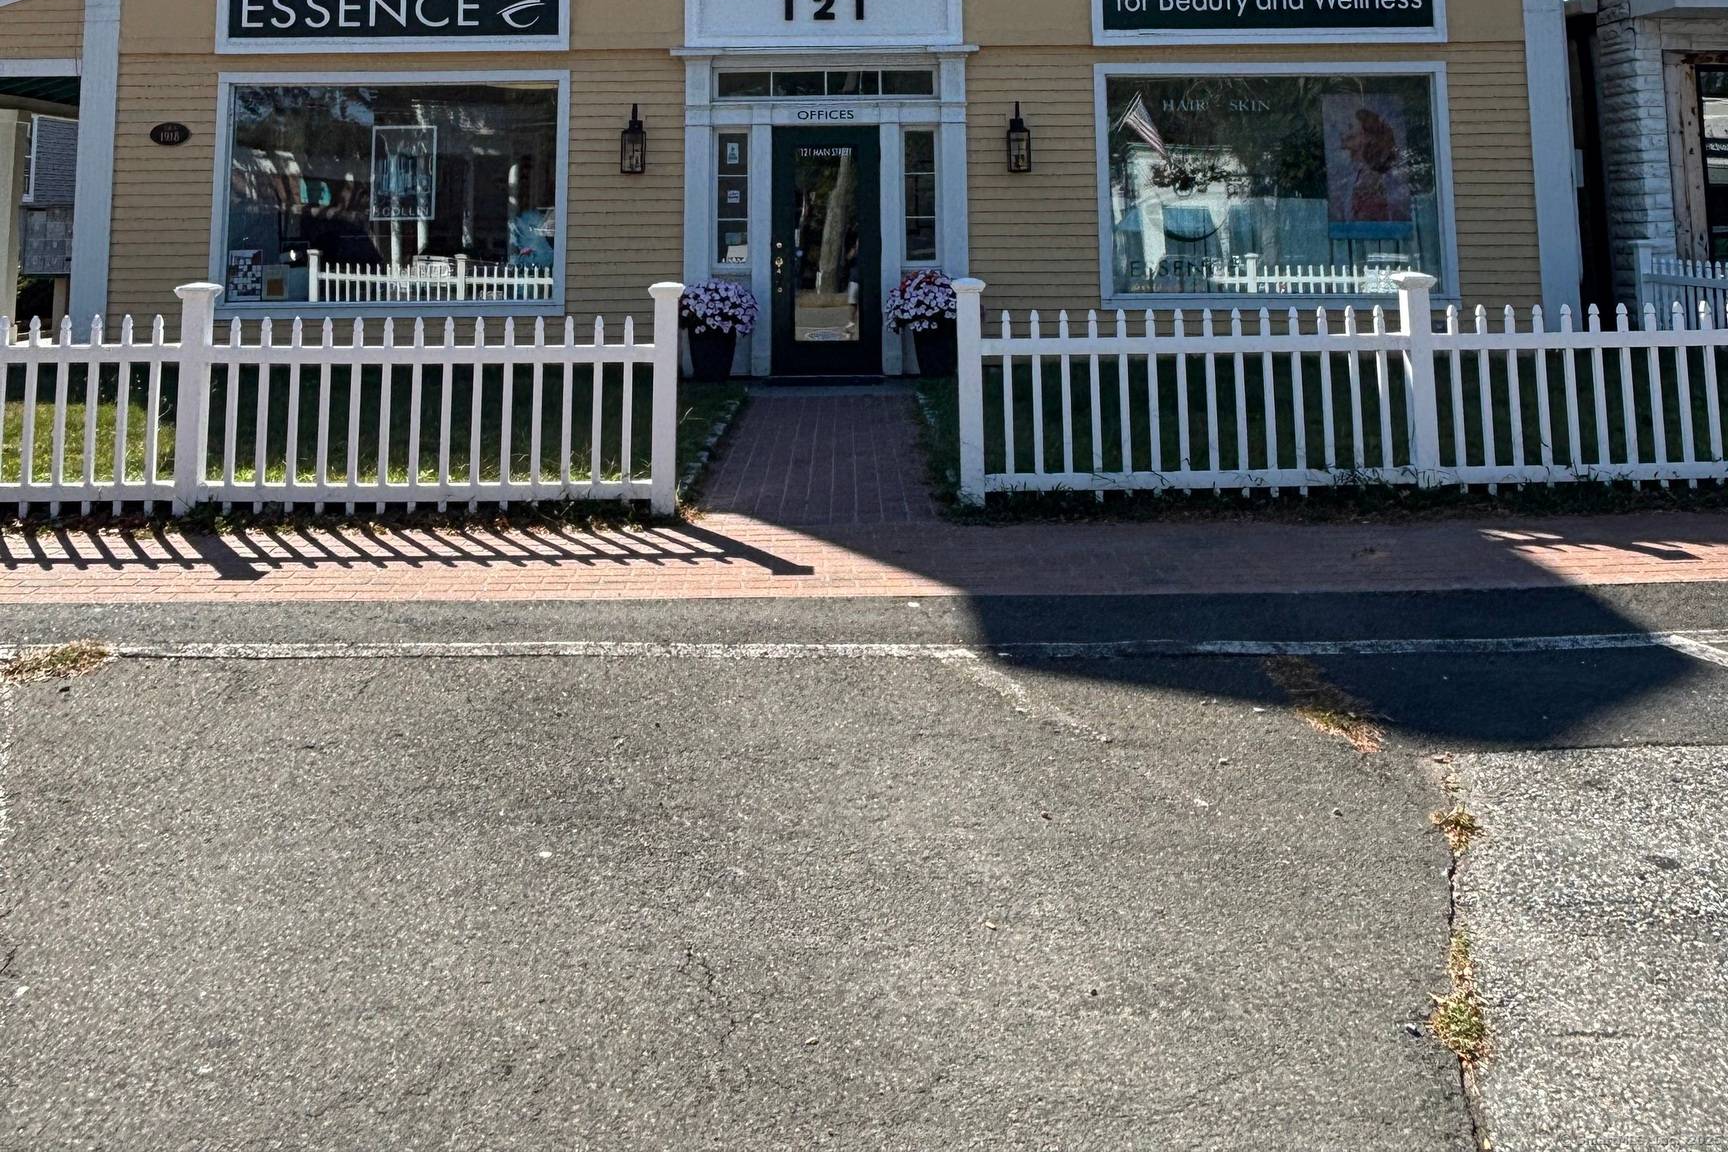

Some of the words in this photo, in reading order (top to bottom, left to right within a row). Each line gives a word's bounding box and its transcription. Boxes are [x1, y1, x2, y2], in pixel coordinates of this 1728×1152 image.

[1162, 99, 1208, 112] HAIR
[1230, 98, 1271, 112] SKIN
[797, 109, 855, 120] OFFICES
